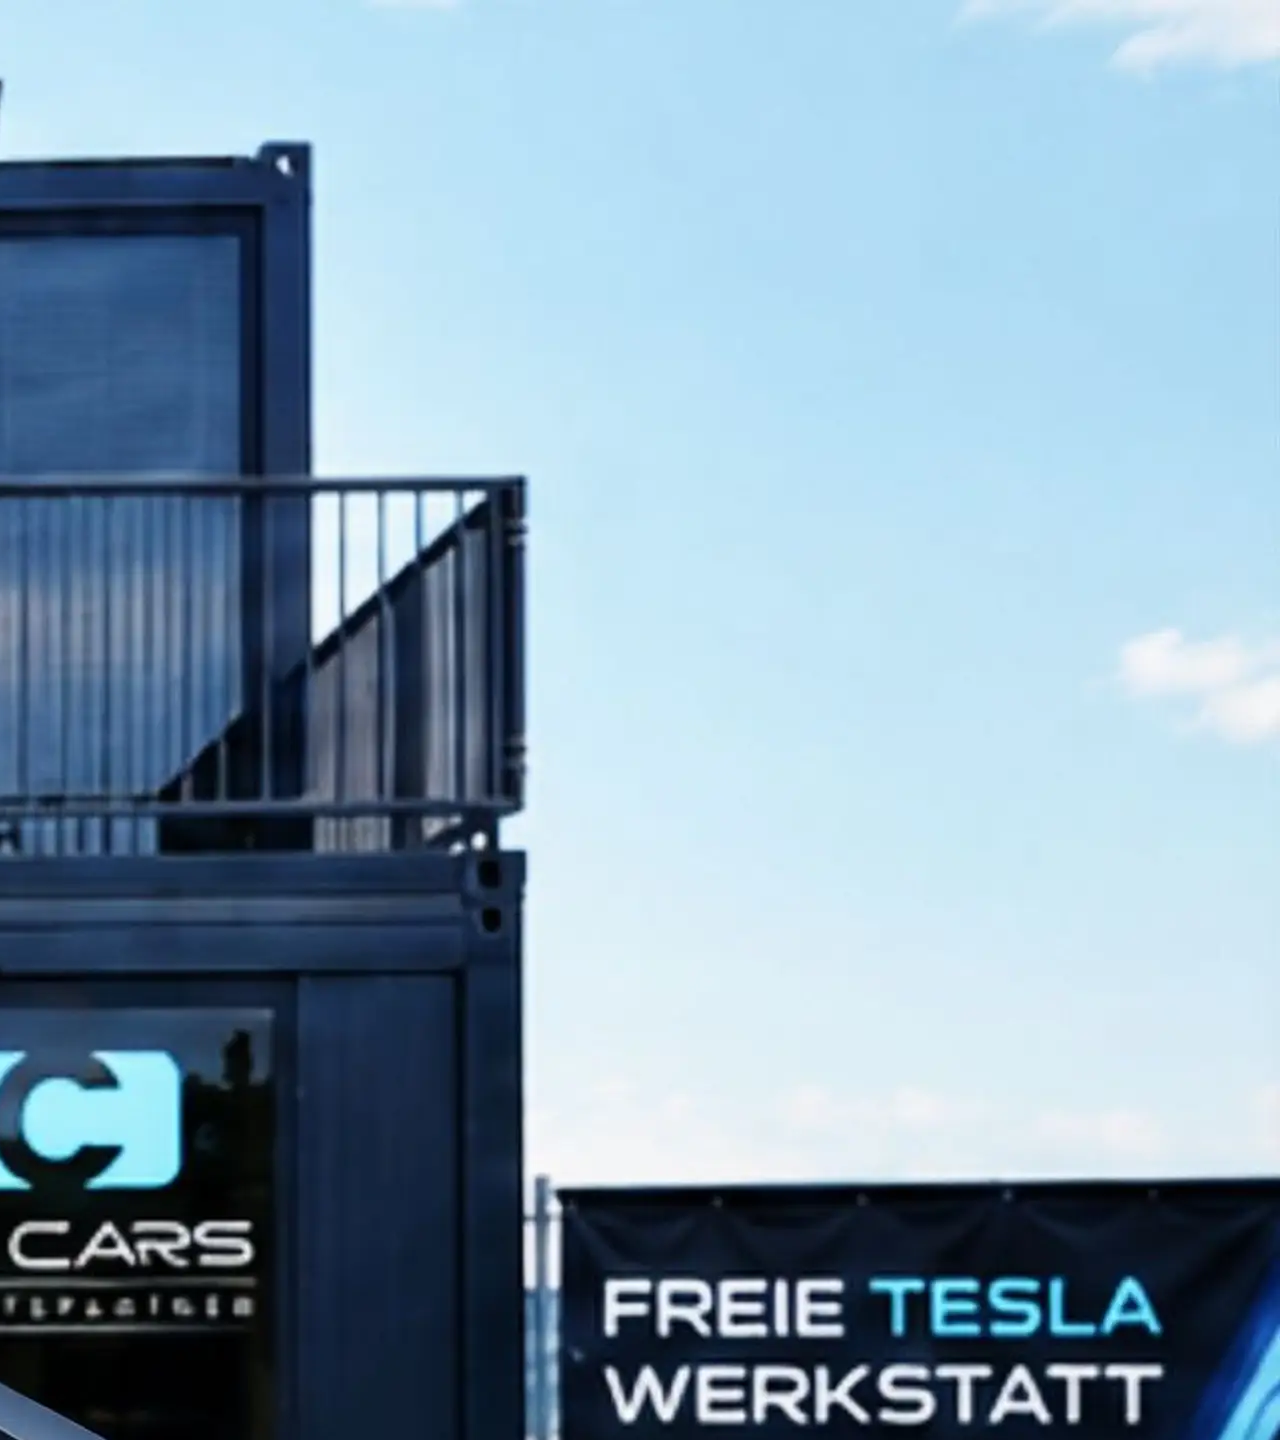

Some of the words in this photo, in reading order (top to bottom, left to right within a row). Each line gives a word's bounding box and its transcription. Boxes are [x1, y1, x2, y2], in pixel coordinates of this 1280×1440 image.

[7, 1220, 255, 1270] CARS
[602, 1277, 846, 1338] FREIE
[868, 1275, 1162, 1337] TESLA
[604, 1363, 1164, 1425] WERKSTATT
